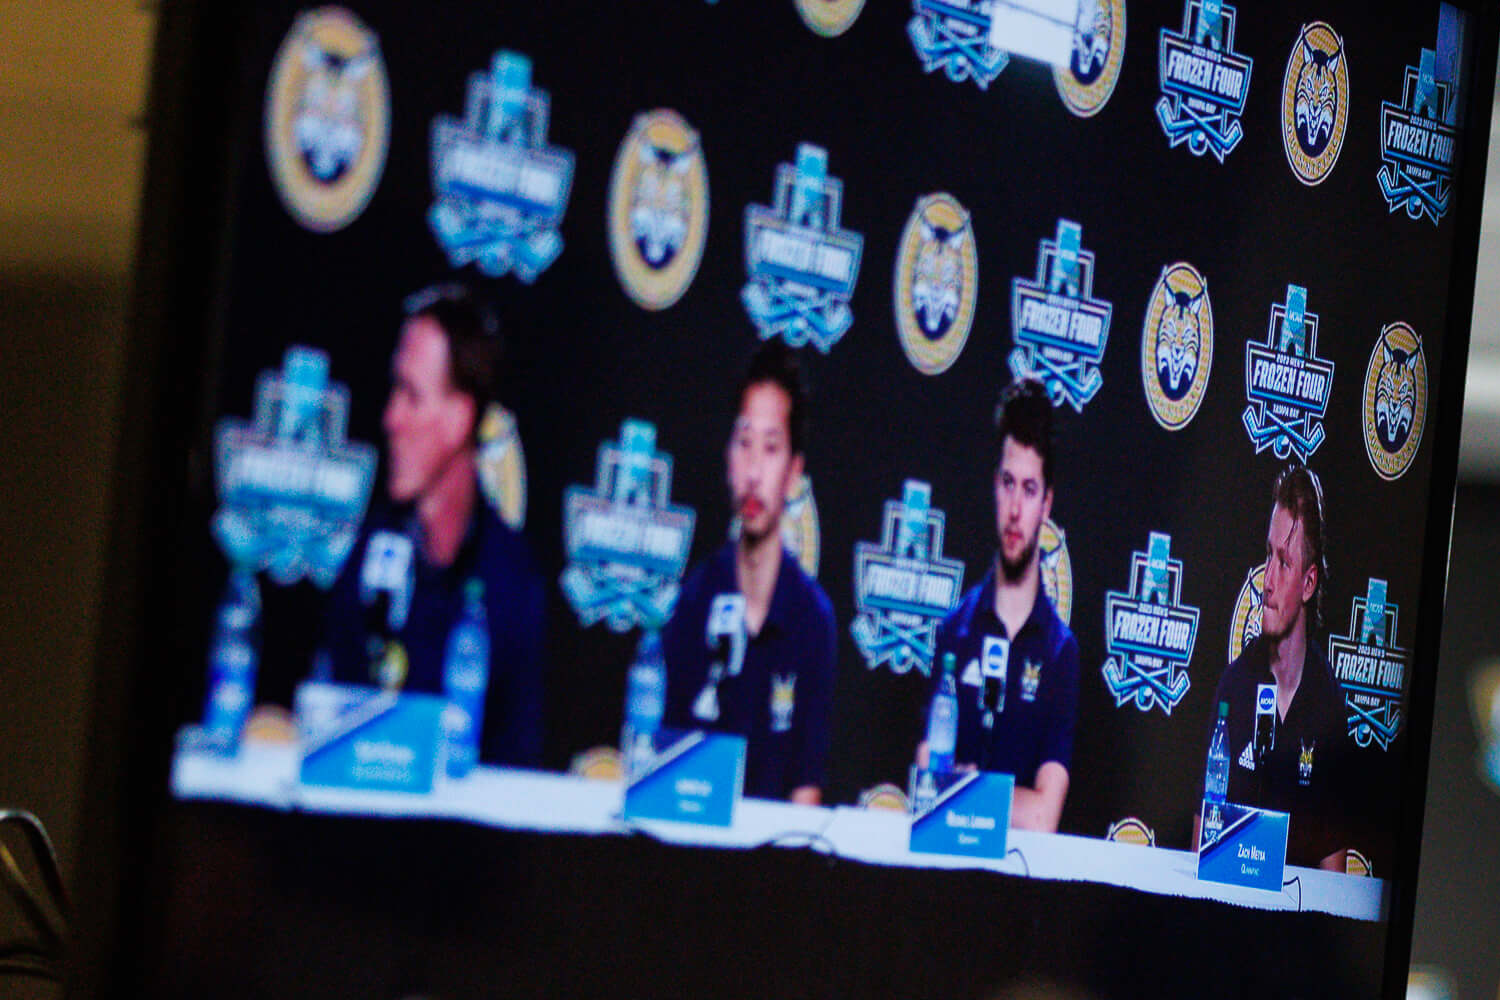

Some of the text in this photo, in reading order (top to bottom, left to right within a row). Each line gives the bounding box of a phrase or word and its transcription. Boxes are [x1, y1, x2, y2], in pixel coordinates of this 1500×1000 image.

[1167, 49, 1243, 100] FROZEN FOUR
[1387, 119, 1430, 157] FROZEN
[1252, 359, 1326, 402] FROZEN FOUR
[1113, 610, 1190, 651] FROZEN FOUR
[1335, 651, 1378, 685] FROZEN
